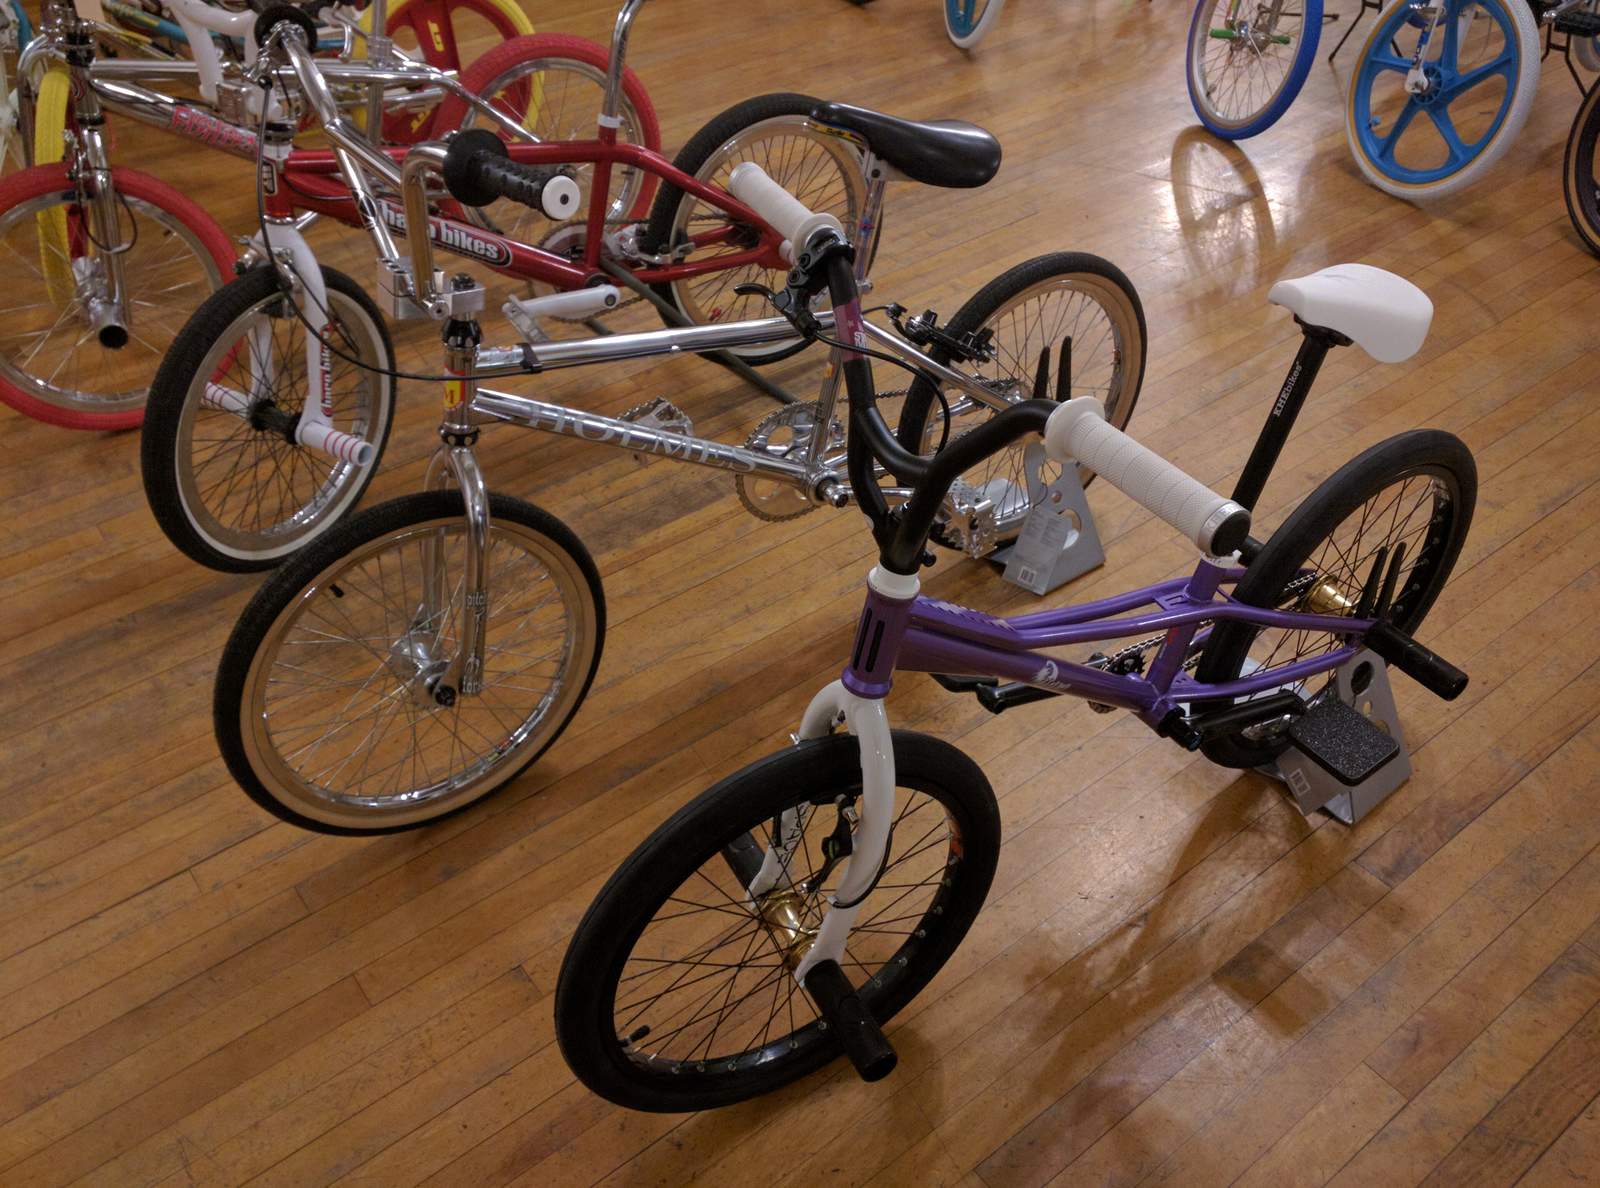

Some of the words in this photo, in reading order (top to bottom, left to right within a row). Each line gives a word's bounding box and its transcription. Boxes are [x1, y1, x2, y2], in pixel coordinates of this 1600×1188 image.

[382, 202, 436, 240] hao
[440, 221, 498, 259] bikes
[525, 404, 758, 473] HOLMES
